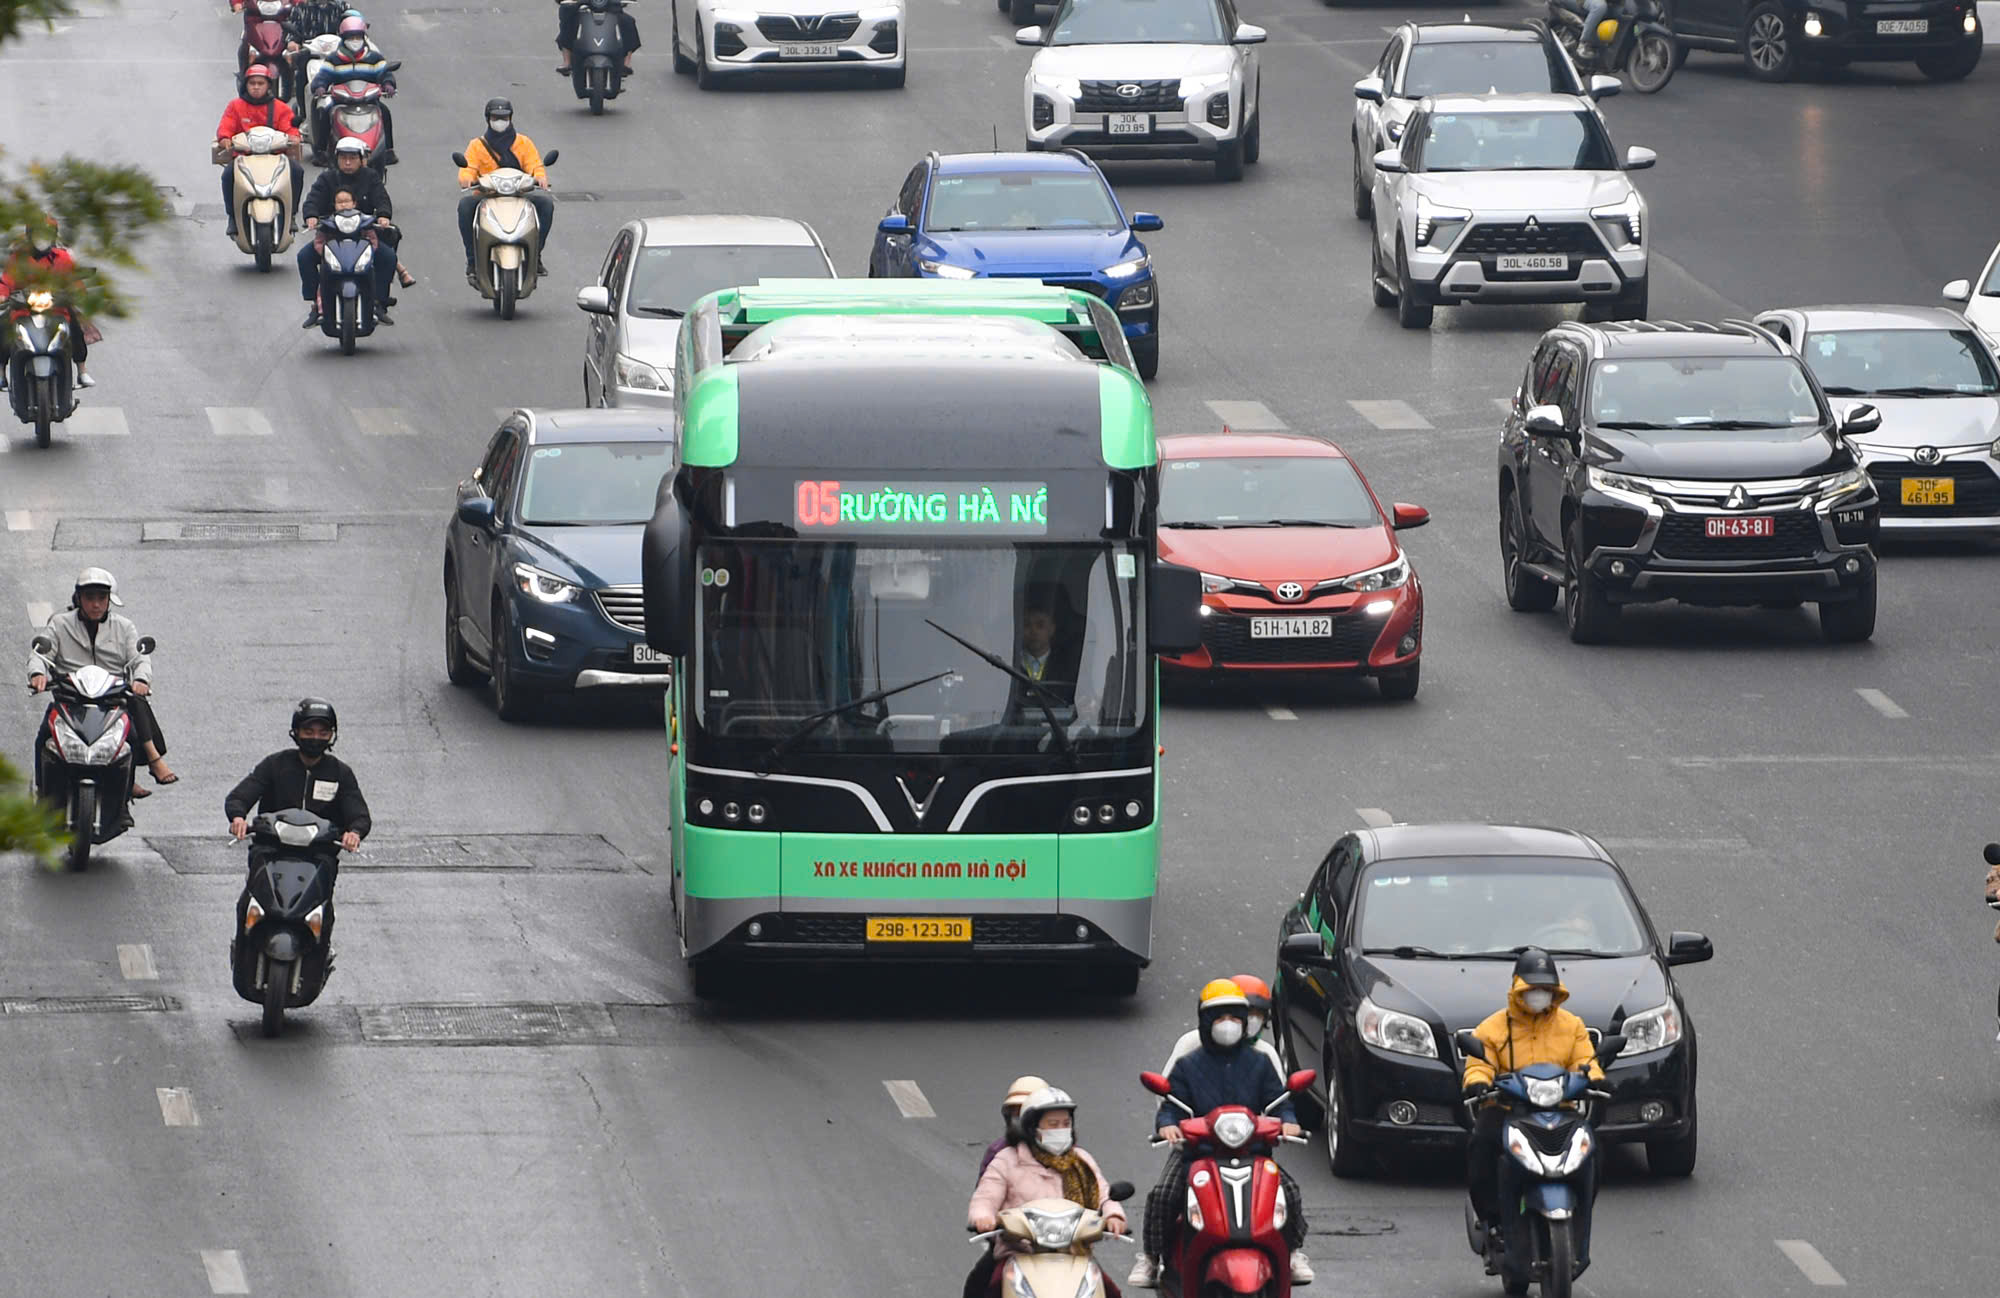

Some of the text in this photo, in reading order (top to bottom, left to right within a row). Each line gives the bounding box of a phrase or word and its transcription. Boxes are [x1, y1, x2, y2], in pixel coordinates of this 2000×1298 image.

[1503, 257, 1562, 269] 30L-460.58
[798, 480, 841, 526] 05
[957, 486, 1001, 523] HÀ
[1254, 620, 1329, 636] 51H-141.82
[839, 861, 858, 878] XE
[862, 858, 917, 878] KHÁCH
[921, 861, 962, 878] NAM
[967, 859, 990, 878] HÀ
[994, 859, 1027, 882] NỘI
[875, 923, 963, 937] 29B-123.30
